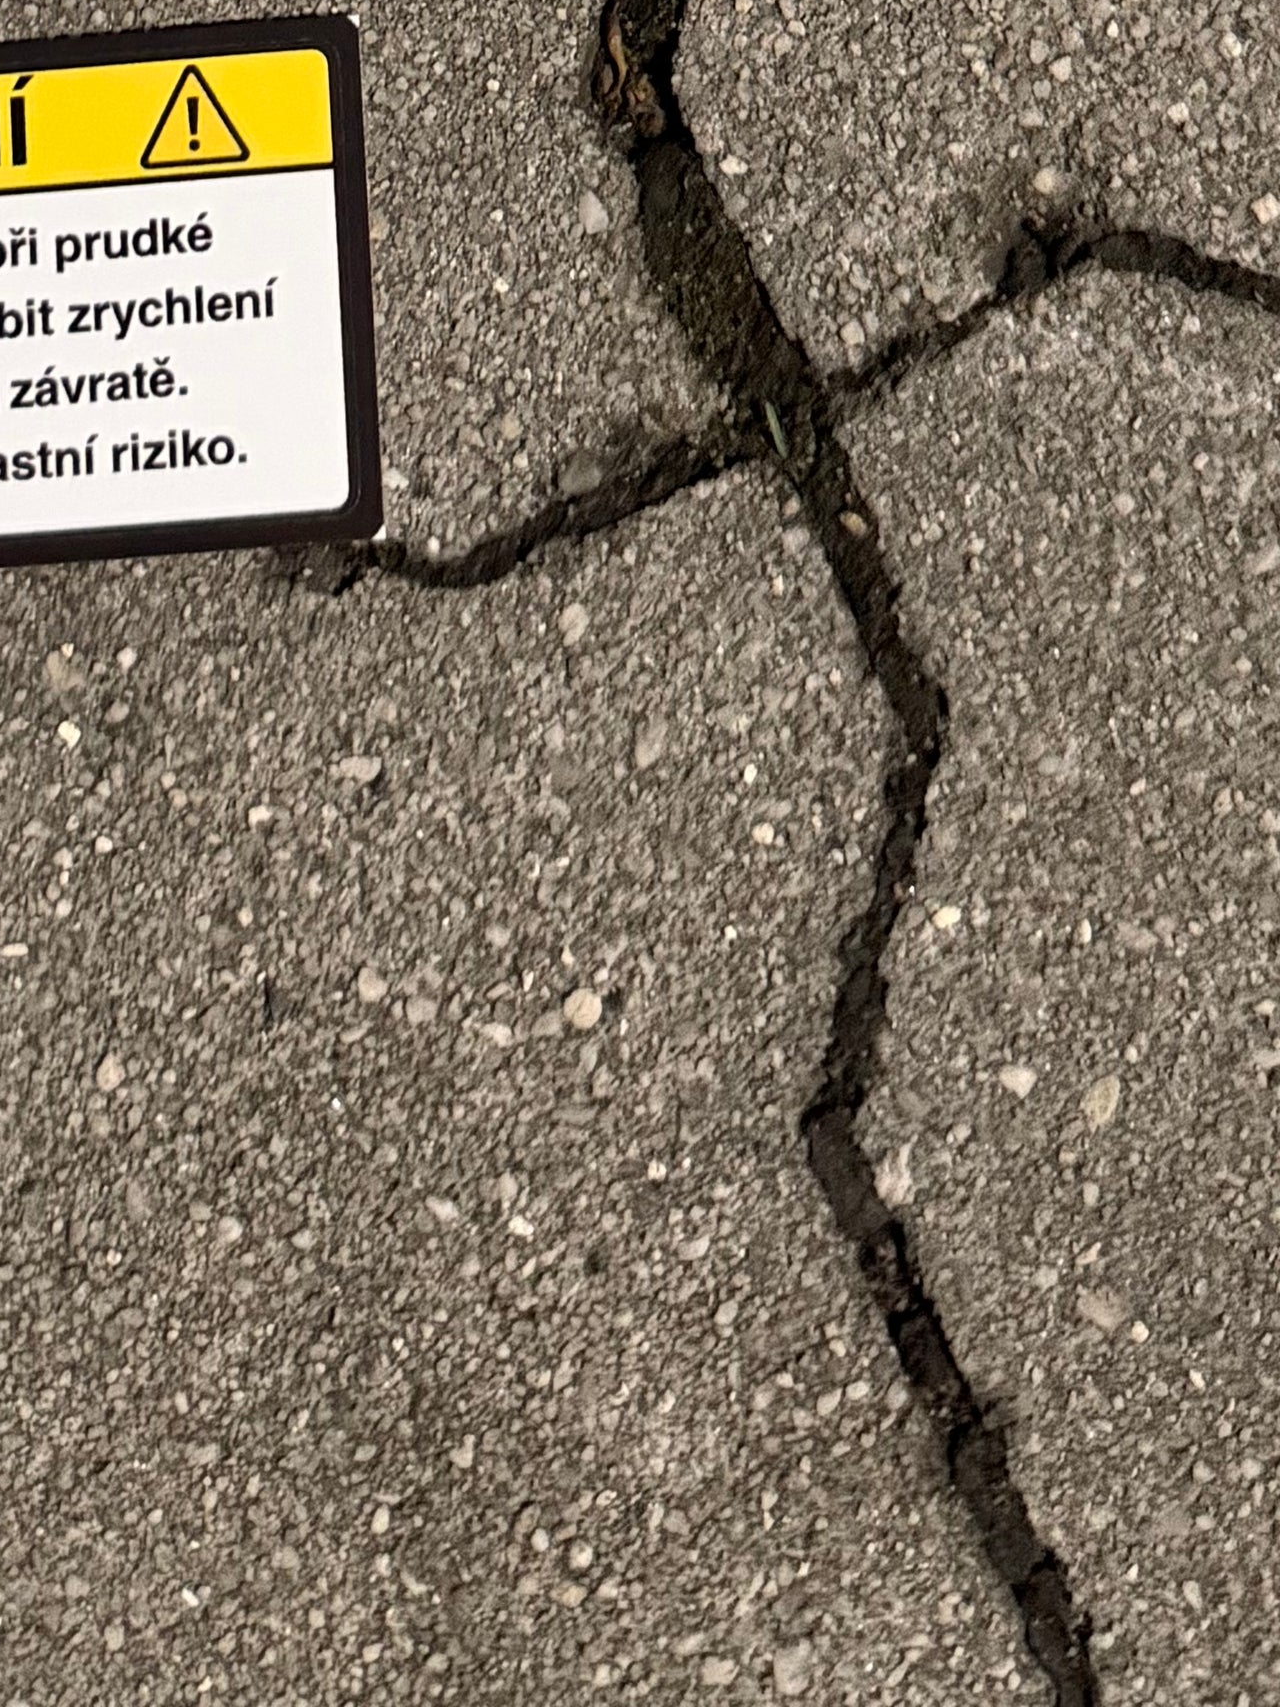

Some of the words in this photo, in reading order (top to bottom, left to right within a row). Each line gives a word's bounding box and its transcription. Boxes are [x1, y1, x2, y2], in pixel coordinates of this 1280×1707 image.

[55, 211, 213, 274] prudké
[67, 277, 278, 341] zrychlení
[9, 356, 188, 409] závratě.
[112, 429, 247, 473] riziko.
